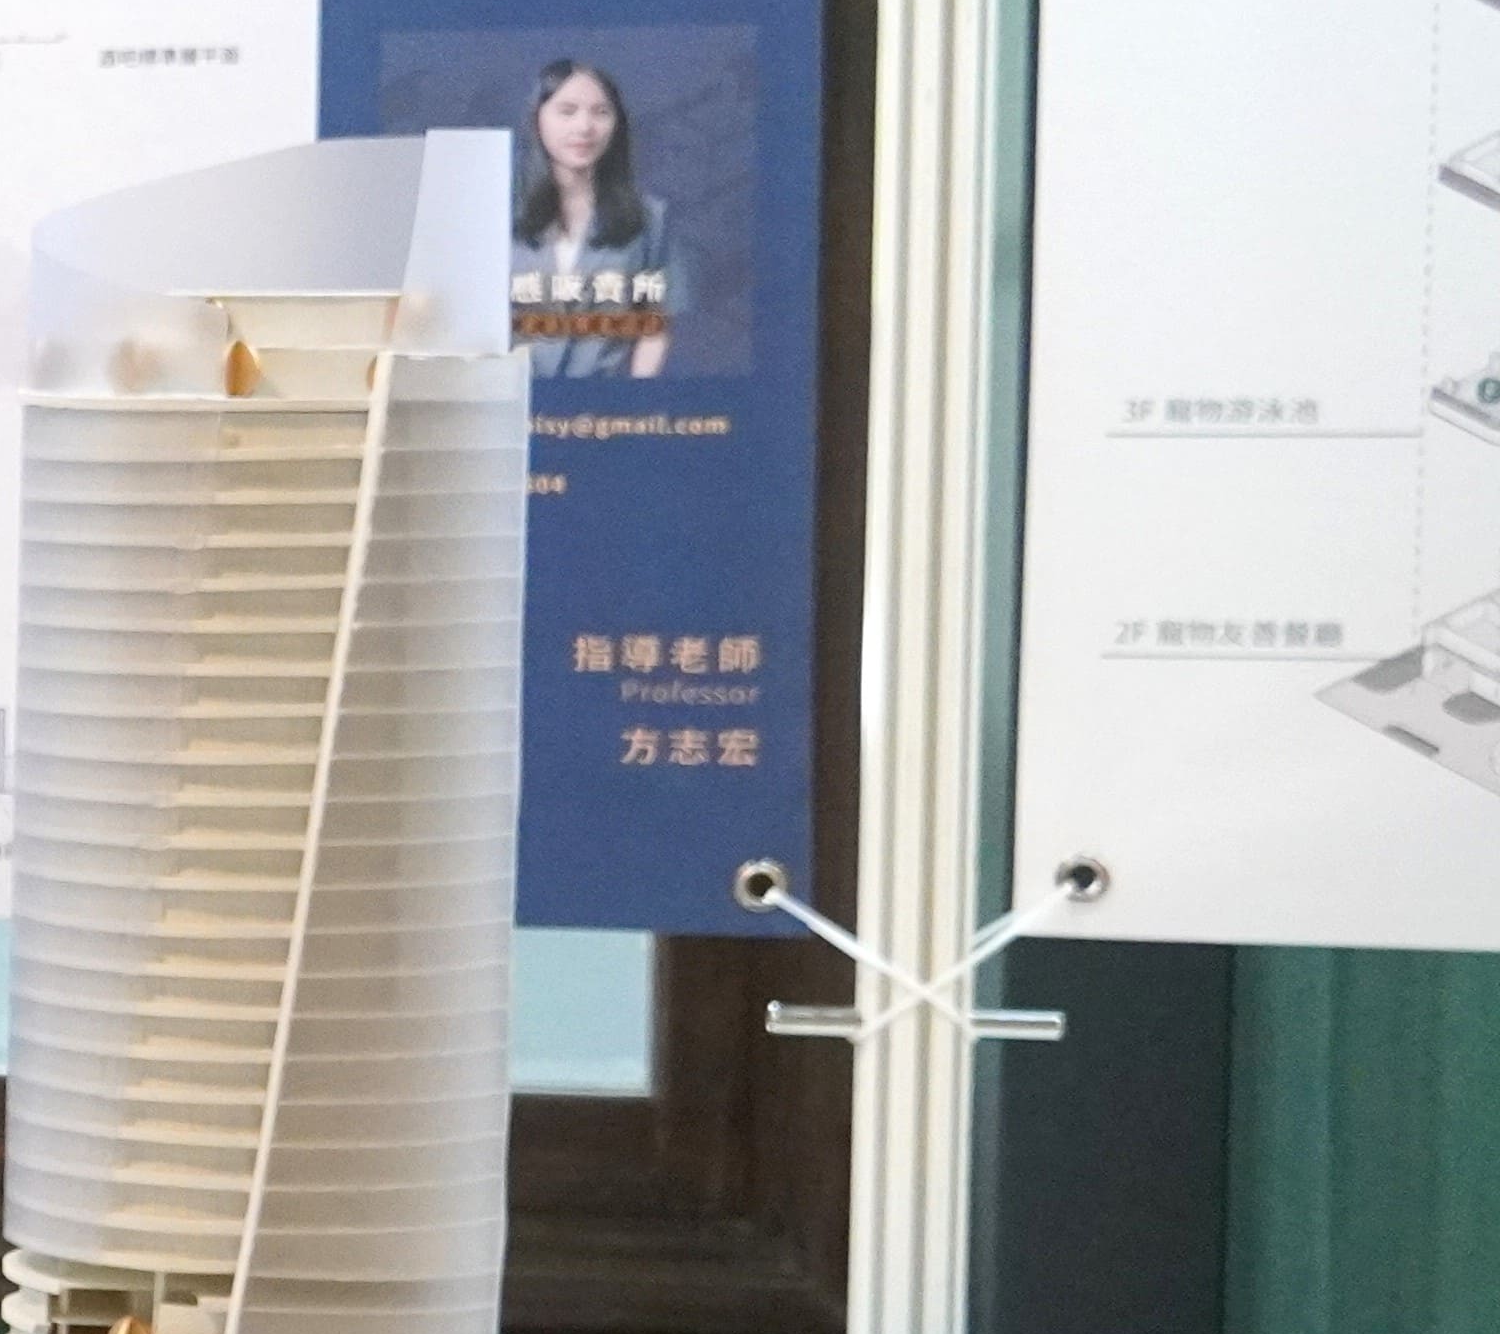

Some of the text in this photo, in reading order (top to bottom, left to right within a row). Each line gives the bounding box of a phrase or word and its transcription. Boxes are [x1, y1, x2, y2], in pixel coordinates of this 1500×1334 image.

[573, 633, 763, 674] 指導老師
[620, 677, 762, 705] Professor
